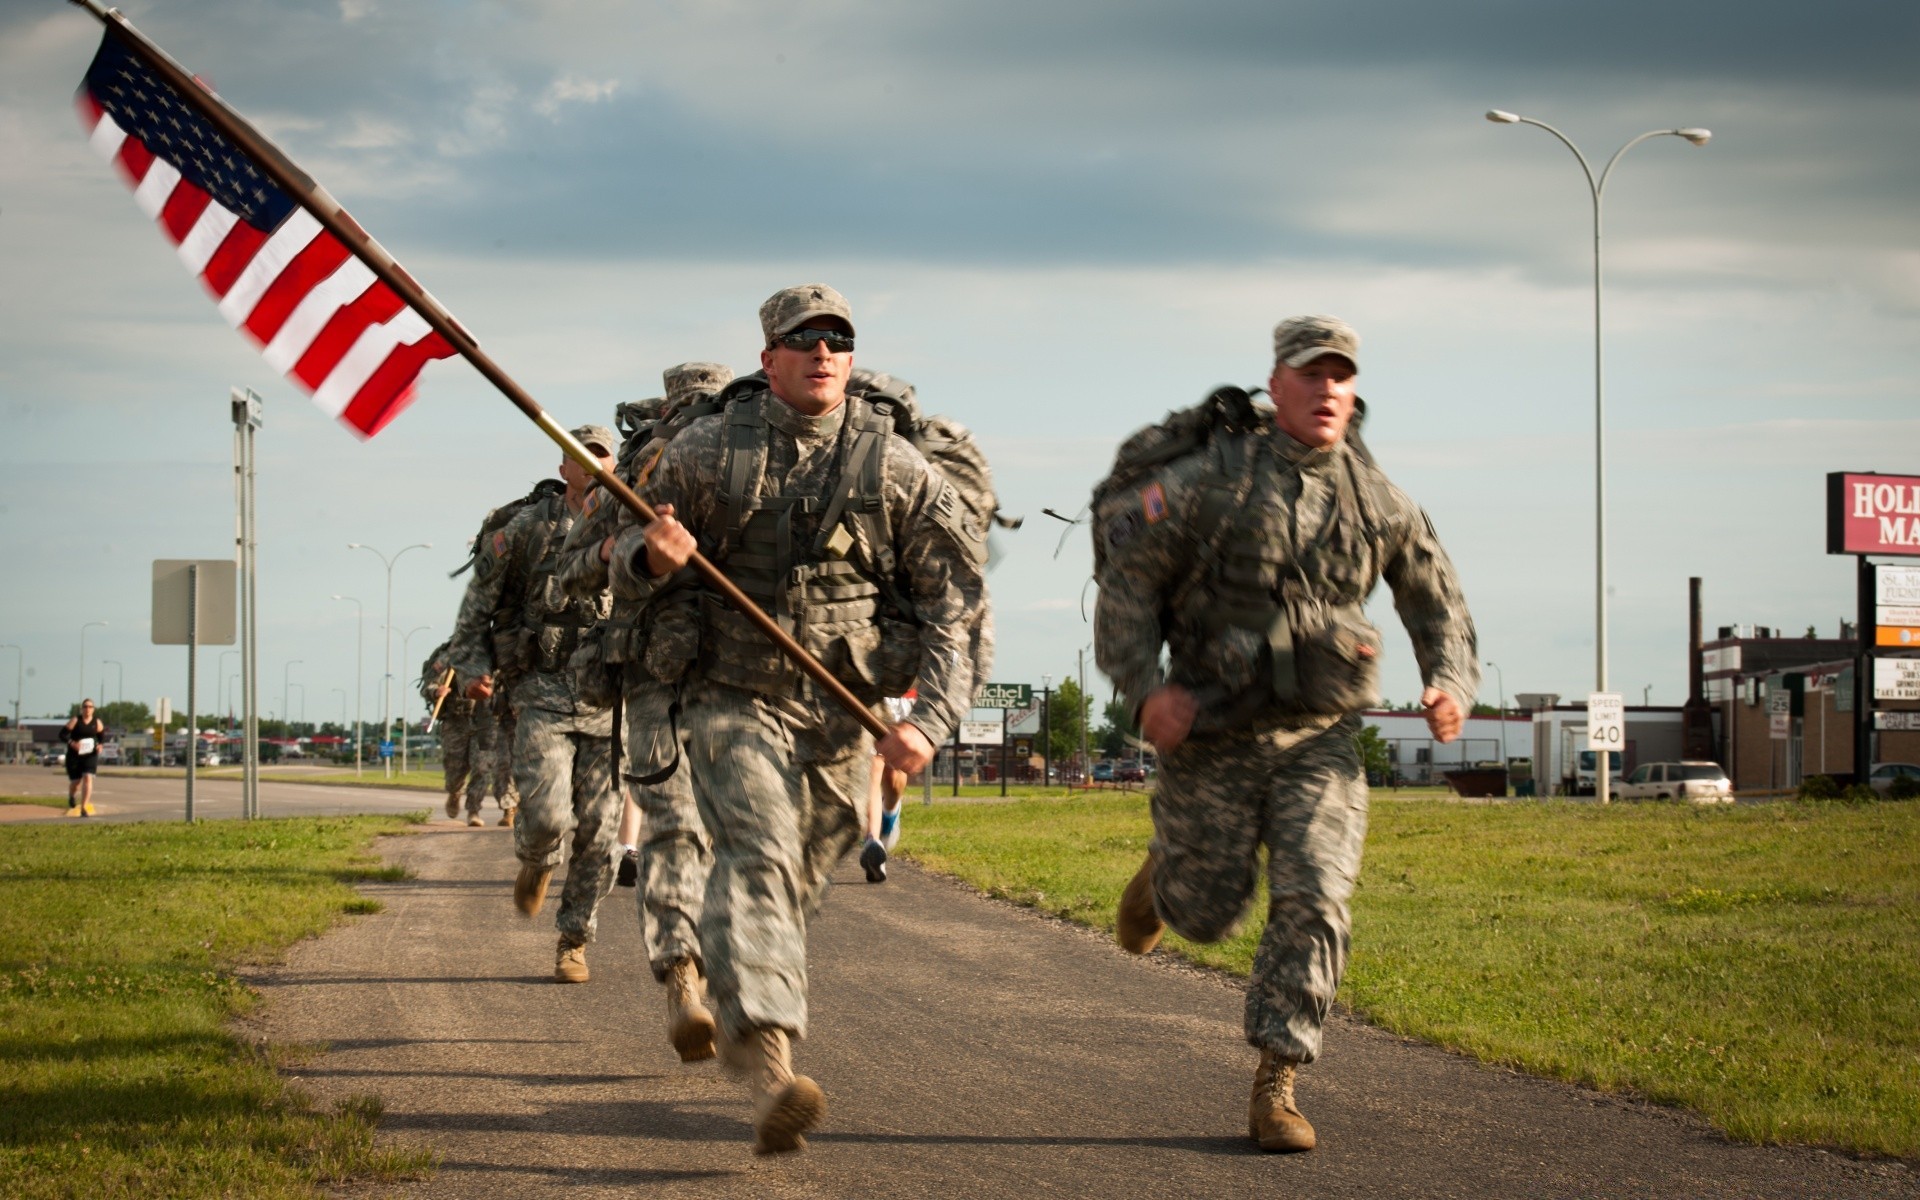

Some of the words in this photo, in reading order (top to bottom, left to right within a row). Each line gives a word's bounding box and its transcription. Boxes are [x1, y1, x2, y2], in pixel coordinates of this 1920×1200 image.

[940, 483, 957, 512] MP
[973, 698, 1016, 708] NITURE
[1592, 699, 1620, 708] SPEED
[1772, 701, 1788, 711] 25
[1594, 712, 1617, 721] LIMIT
[1593, 726, 1620, 743] 40
